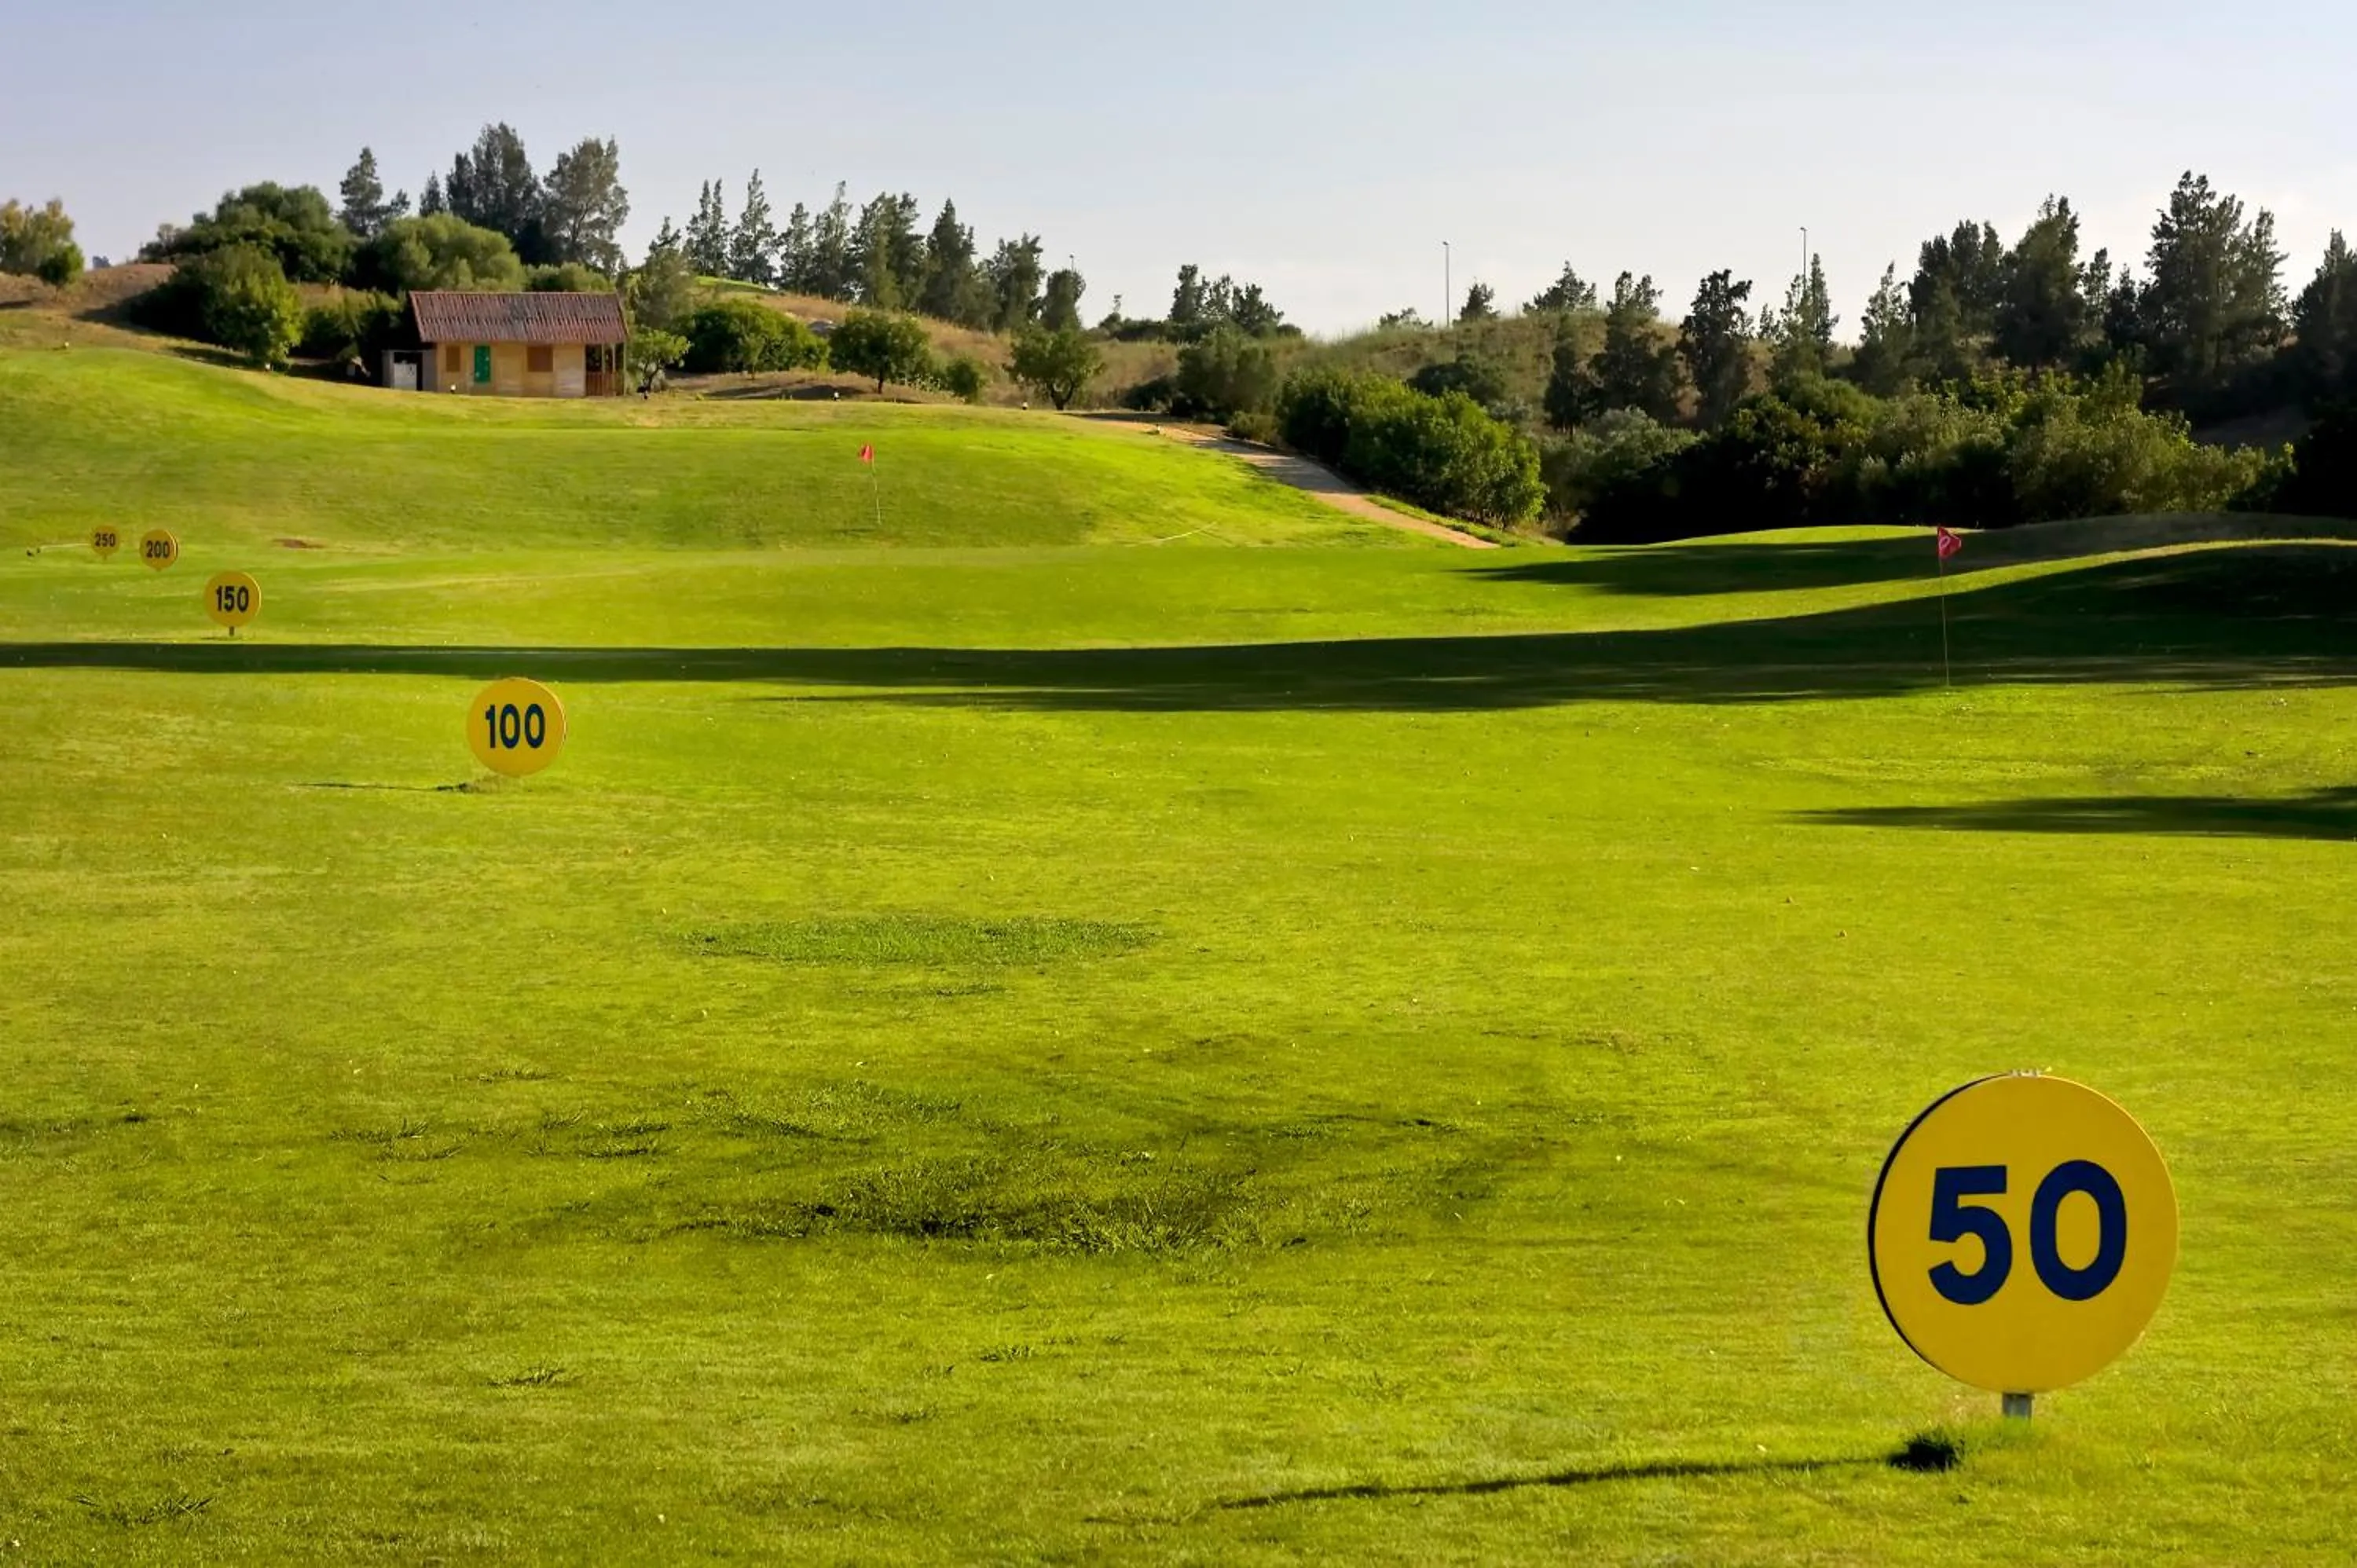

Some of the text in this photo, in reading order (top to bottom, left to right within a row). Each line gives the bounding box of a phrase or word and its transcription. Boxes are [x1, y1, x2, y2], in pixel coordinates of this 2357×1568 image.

[95, 533, 115, 548] 250
[146, 540, 170, 558] 200
[215, 586, 249, 612] 150
[485, 703, 546, 749] 100
[1927, 1160, 2127, 1306] 50
